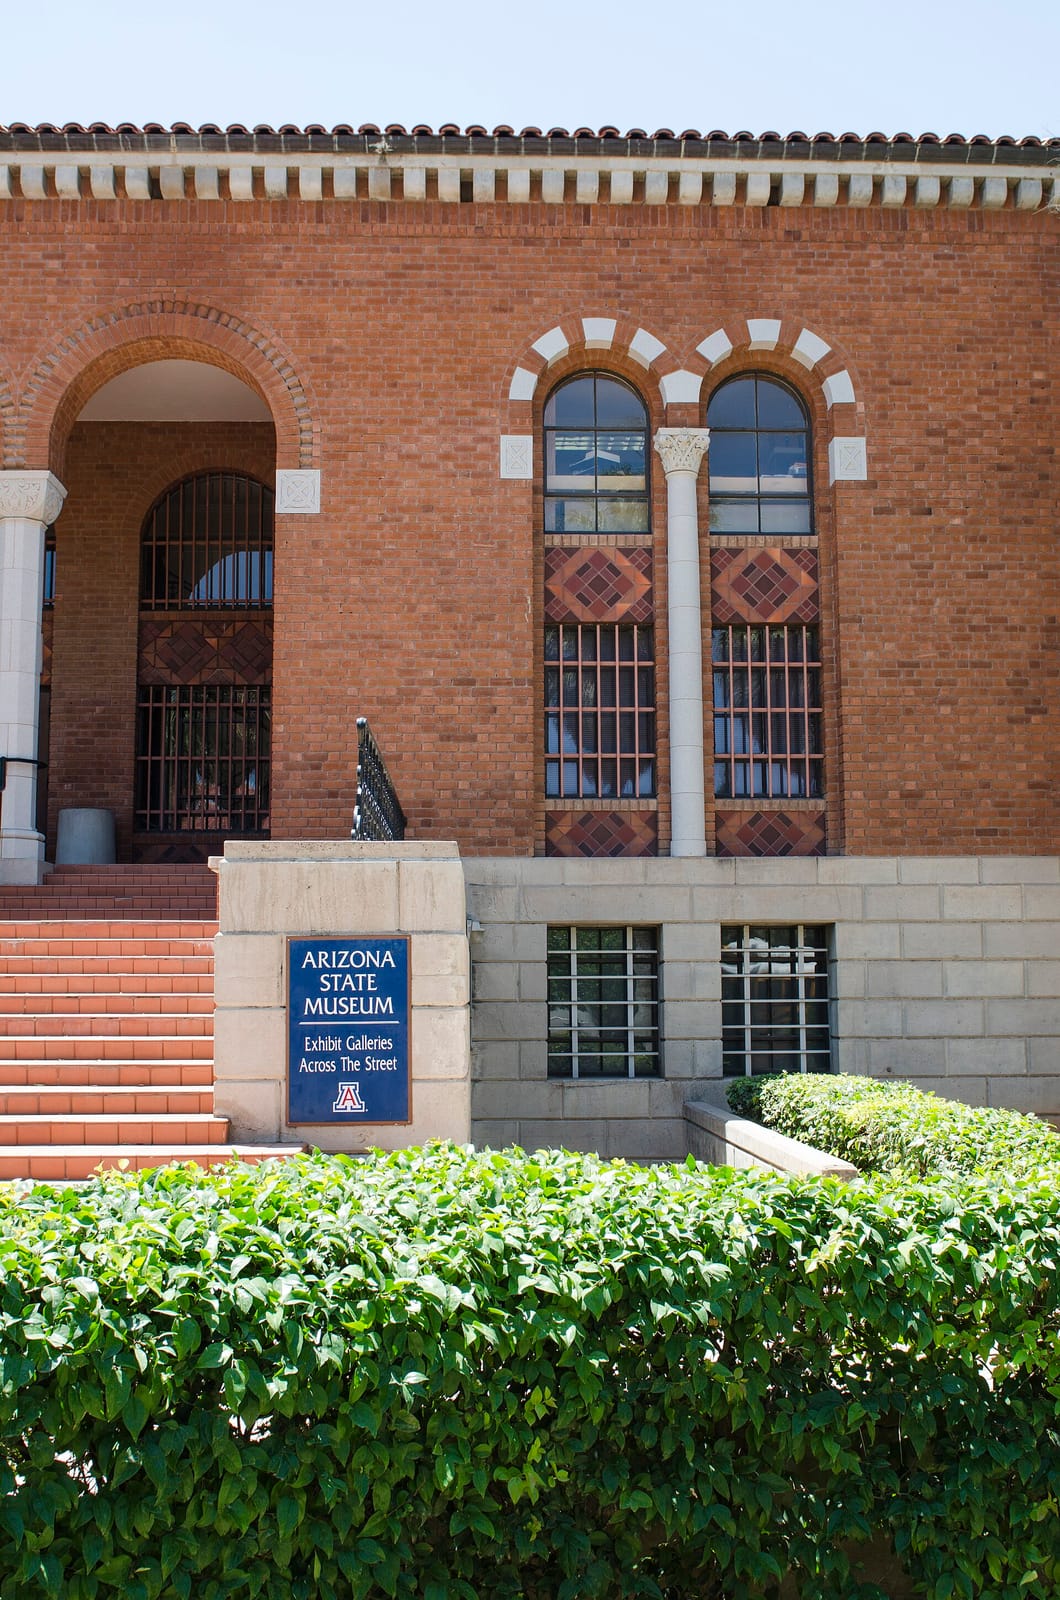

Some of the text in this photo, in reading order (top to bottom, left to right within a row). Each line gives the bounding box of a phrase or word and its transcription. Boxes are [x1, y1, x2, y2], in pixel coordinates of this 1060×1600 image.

[301, 950, 396, 968] ARIZONA
[320, 973, 378, 991] STATE
[304, 996, 394, 1015] MUSEUM
[304, 1035, 393, 1052] Exhibit Galleries
[299, 1056, 397, 1073] Across The Street
